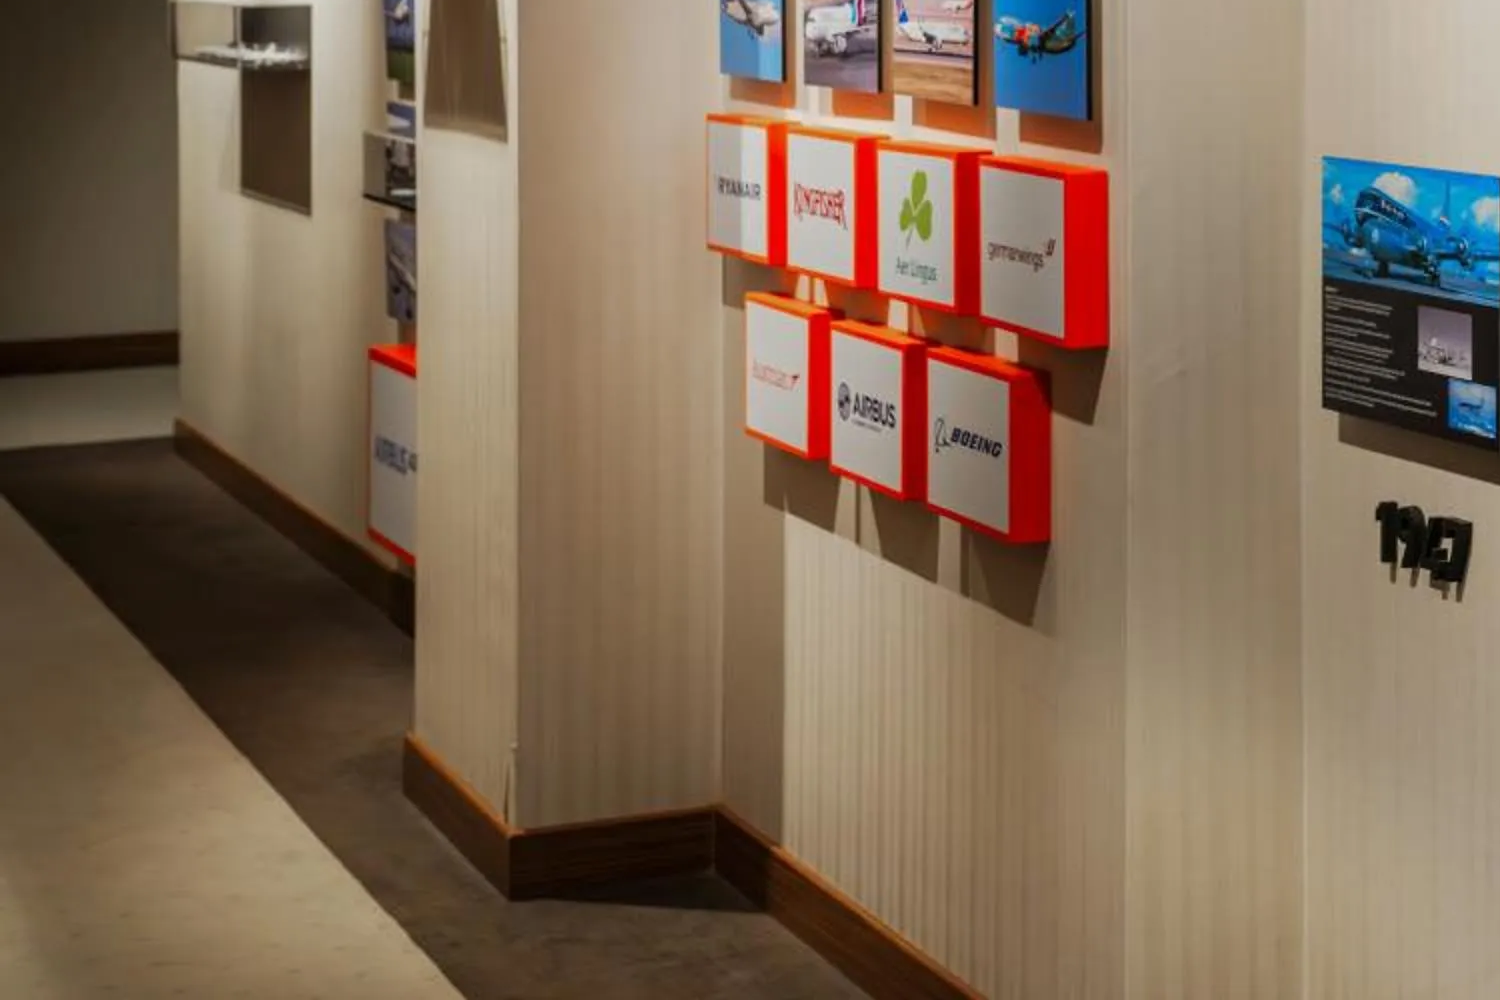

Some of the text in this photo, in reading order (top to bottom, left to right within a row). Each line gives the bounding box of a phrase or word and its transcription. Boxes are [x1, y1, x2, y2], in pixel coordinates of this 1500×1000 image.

[718, 176, 761, 200] RYANAIR
[988, 241, 1045, 272] germanwings
[853, 392, 896, 429] AIRBUS
[951, 427, 1002, 457] BOEING
